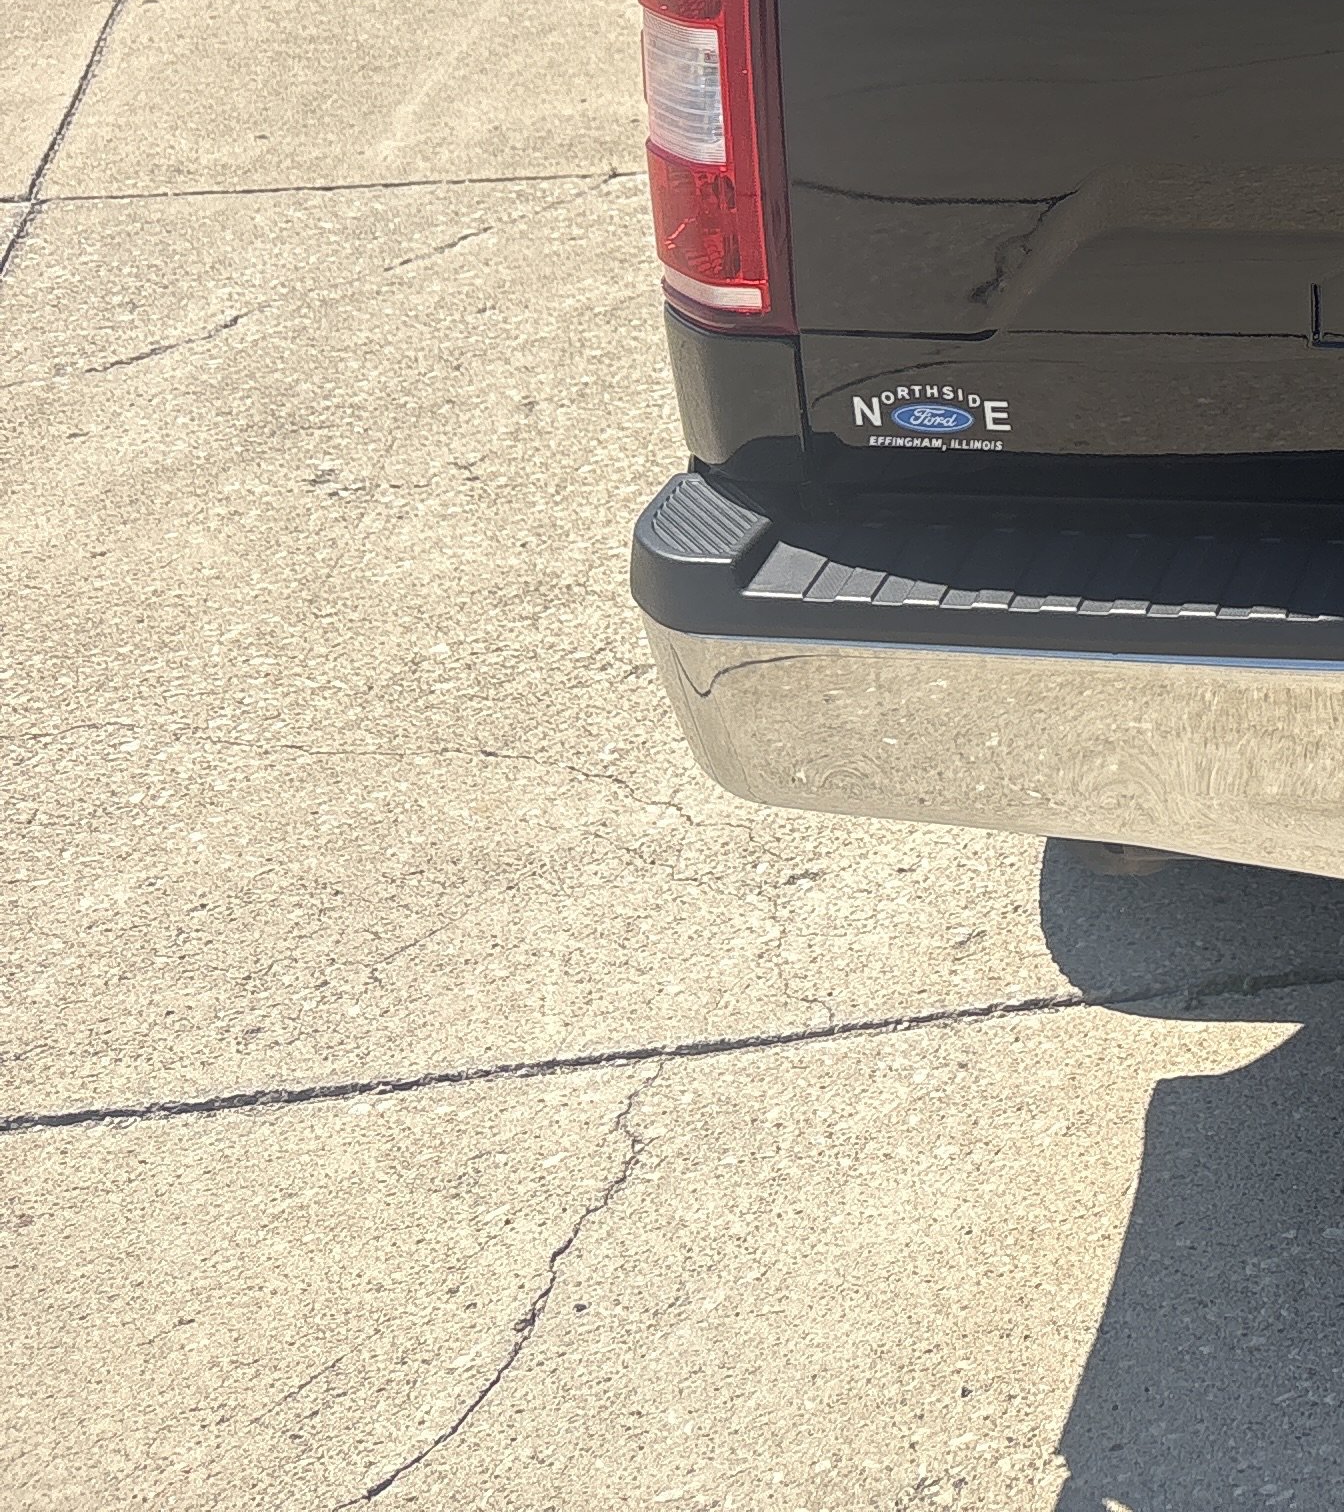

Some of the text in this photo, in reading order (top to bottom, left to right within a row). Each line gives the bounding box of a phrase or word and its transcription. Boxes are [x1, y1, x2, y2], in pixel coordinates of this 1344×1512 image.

[852, 384, 1013, 432] NORTHSIDE
[909, 407, 957, 427] Ford
[869, 435, 1004, 452] EFFINGHAM, ILLINOIS
